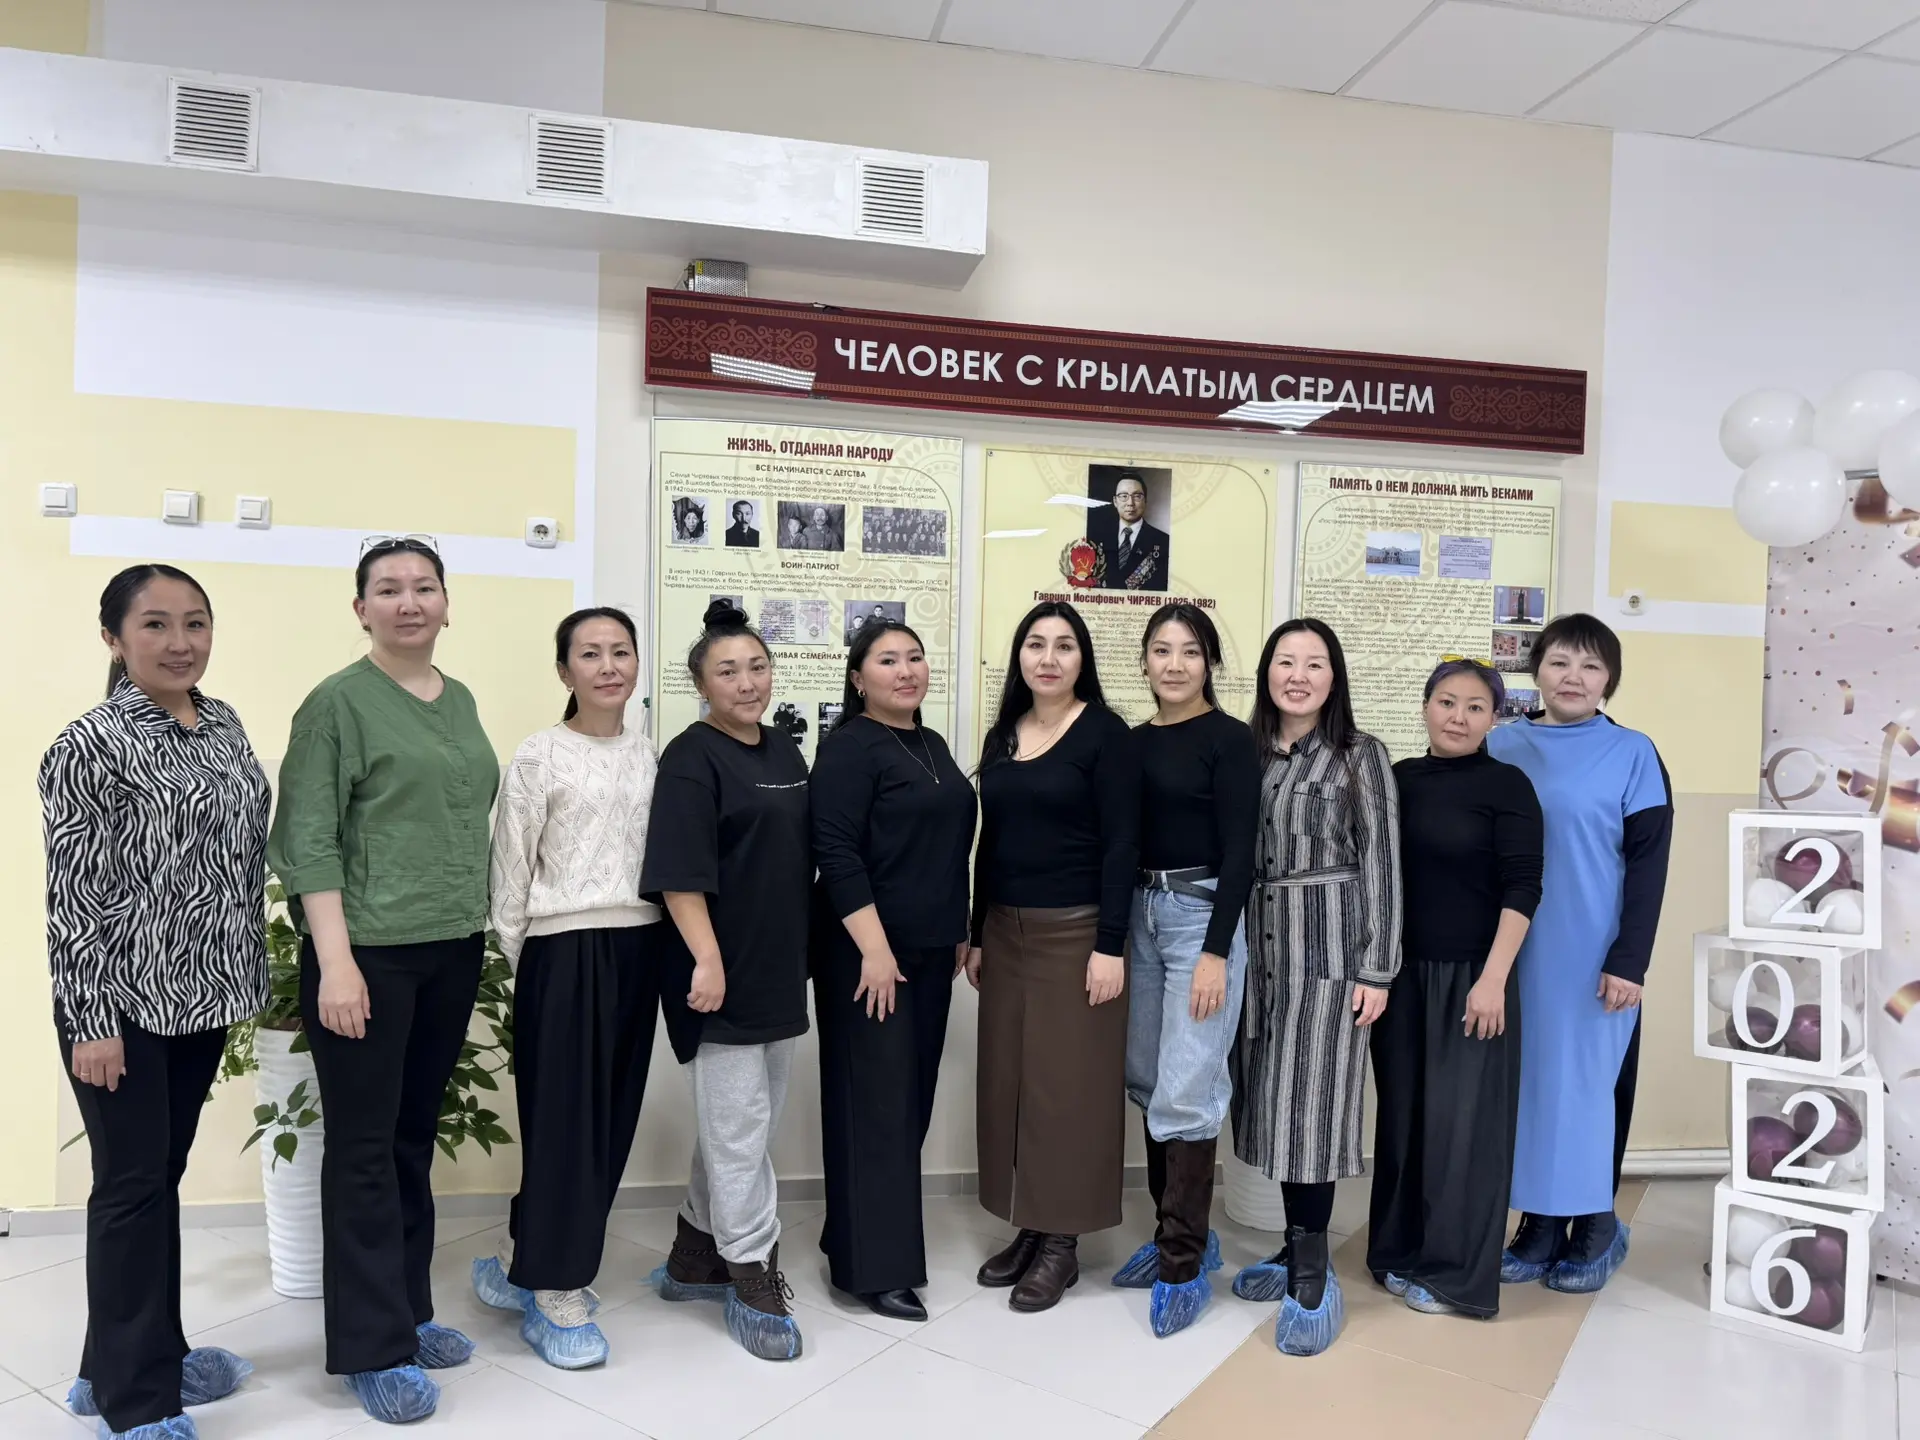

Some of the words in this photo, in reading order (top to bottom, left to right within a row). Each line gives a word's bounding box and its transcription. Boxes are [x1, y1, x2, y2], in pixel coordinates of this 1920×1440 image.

[834, 338, 1003, 382] ЧЕЛОВЕК
[1016, 354, 1044, 386] С
[1056, 357, 1258, 401] КРЫЛАТЫМ
[1270, 374, 1434, 414] СЕРДЦЕМ
[727, 437, 776, 454] ЖИЗНЬ,
[780, 440, 843, 458] ОТДАННАЯ
[847, 442, 893, 461] НАРОДУ
[755, 464, 770, 472] ВСЕ
[772, 465, 824, 476] НАЧИНАЕТСЯ
[834, 469, 866, 478] ДЕТСТВА
[1329, 477, 1373, 491] ПАМЯТЬ
[1375, 480, 1383, 491] О
[1386, 480, 1409, 493] НЕМ
[1411, 482, 1457, 496] ДОЛЖНА
[1460, 485, 1489, 498] ЖИТЬ
[1491, 487, 1533, 500] ВЕКАМИ
[780, 561, 839, 571] ВОИН-ПАТРИОТ
[1034, 591, 1071, 603] Гавриил
[1073, 592, 1125, 605] Иосифович
[1127, 595, 1162, 606] ЧИРЯЕВ
[800, 651, 842, 660] СЕМЕЙНАЯ
[1770, 838, 1841, 928] 2
[1732, 960, 1795, 1048] 0
[1771, 1091, 1838, 1184] 2
[1749, 1229, 1817, 1315] 6
